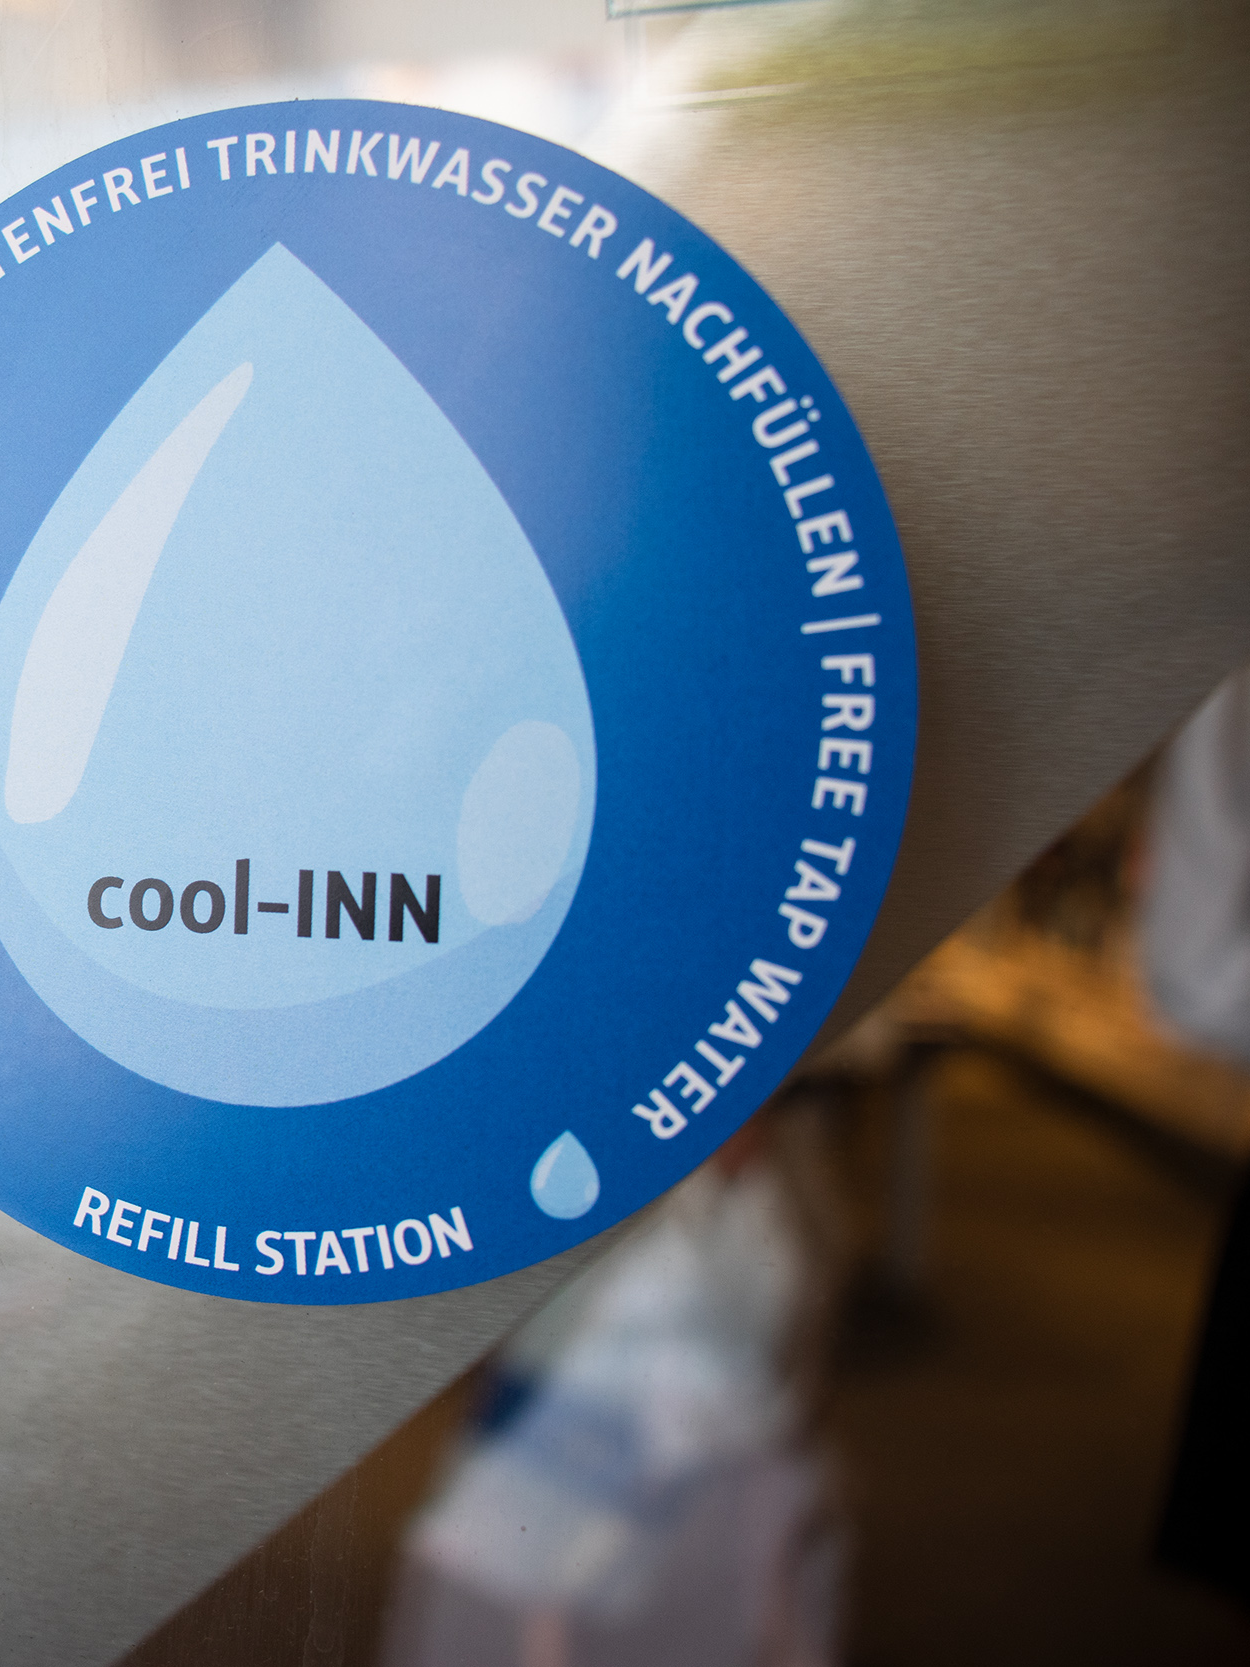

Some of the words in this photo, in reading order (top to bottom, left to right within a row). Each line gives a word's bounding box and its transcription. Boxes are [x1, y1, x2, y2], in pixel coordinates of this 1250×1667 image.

[206, 128, 618, 258] TRINKWASSER
[617, 238, 864, 596] NACHFÜLLEN
[812, 654, 876, 816] FREE
[87, 858, 442, 944] cool-INN
[778, 837, 857, 949] TAP
[631, 958, 803, 1140] WATER
[73, 1186, 240, 1272] REFILL
[254, 1205, 473, 1276] STATION
